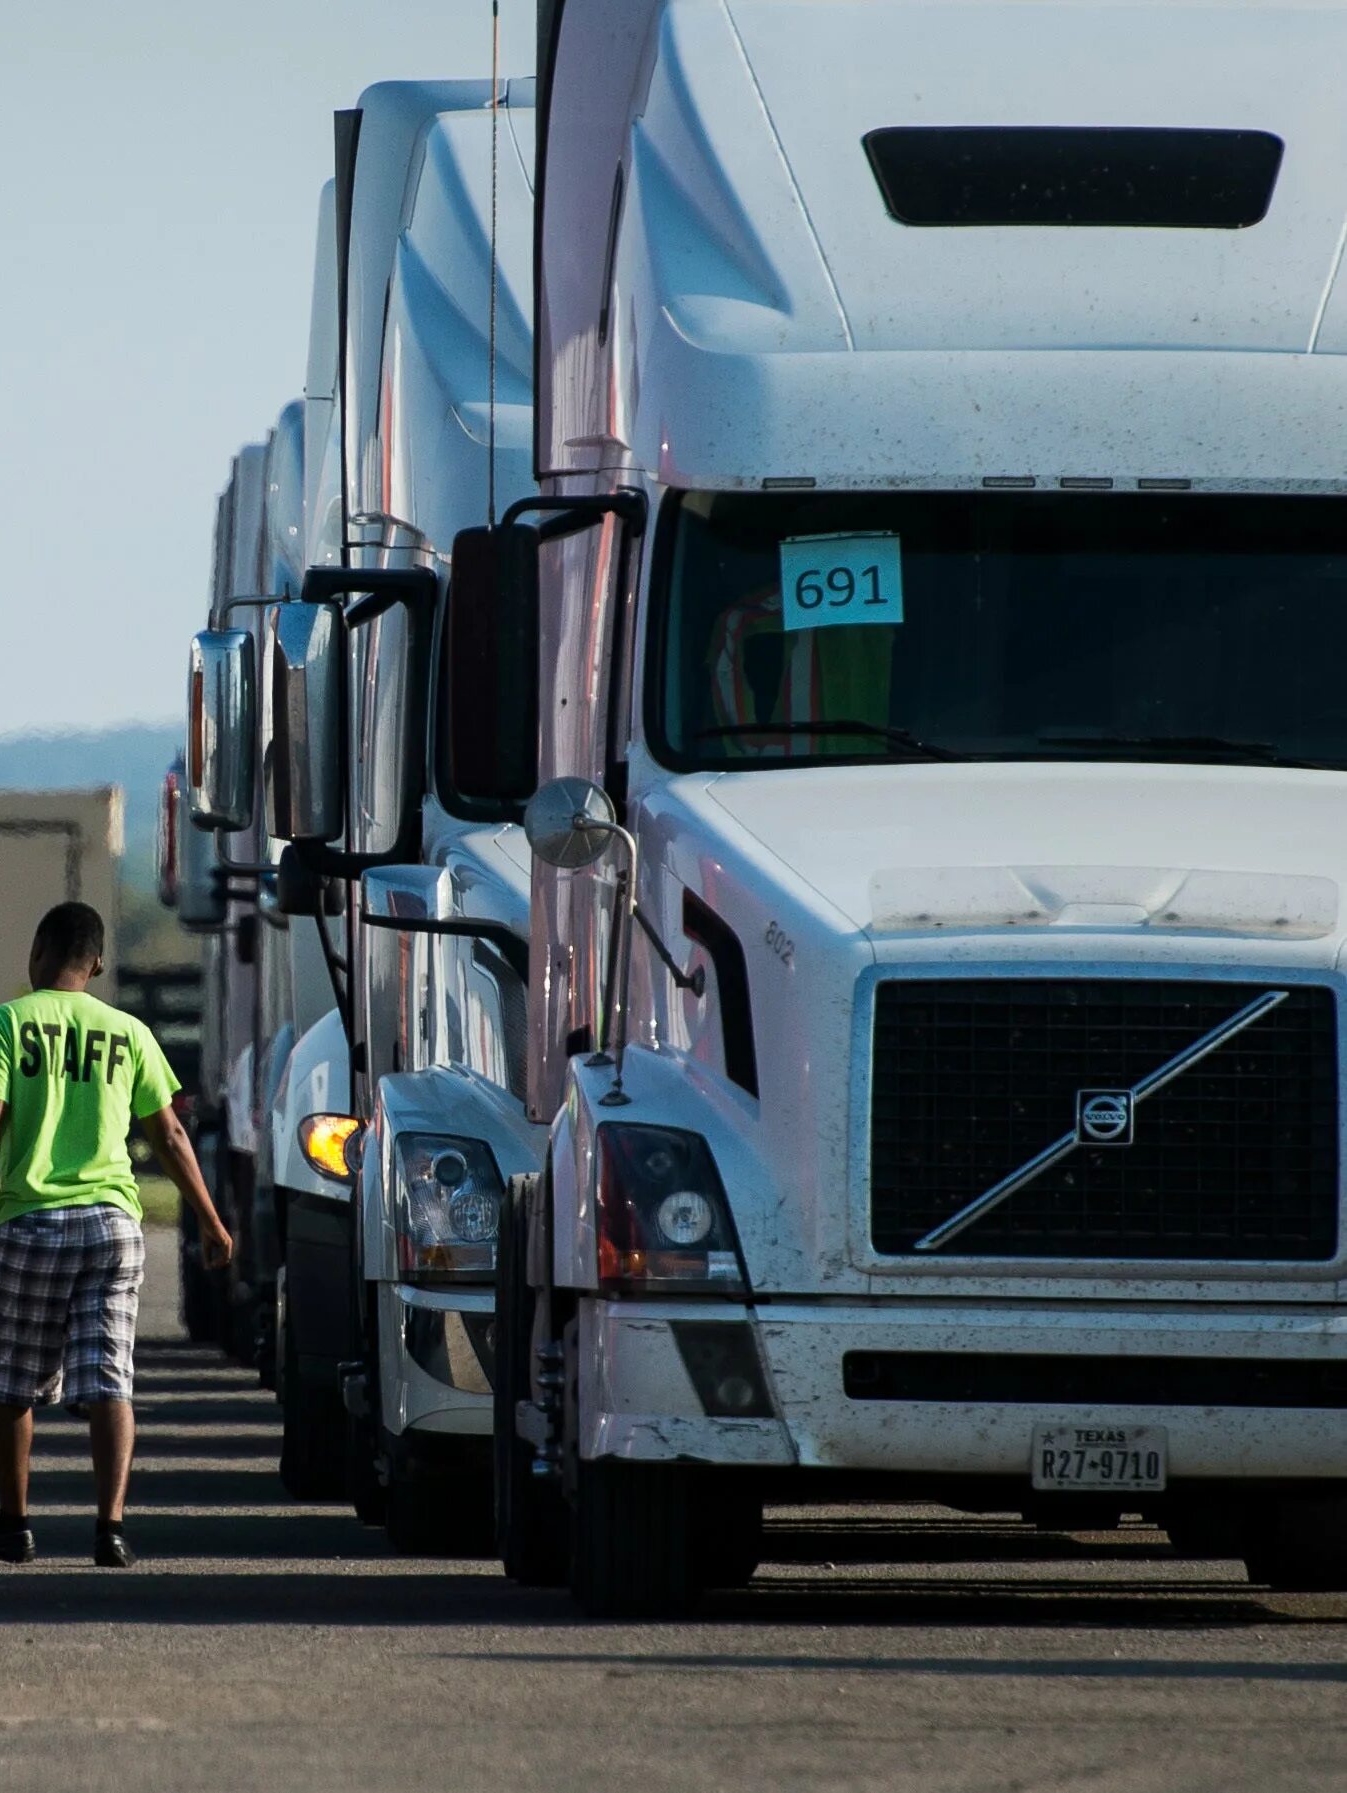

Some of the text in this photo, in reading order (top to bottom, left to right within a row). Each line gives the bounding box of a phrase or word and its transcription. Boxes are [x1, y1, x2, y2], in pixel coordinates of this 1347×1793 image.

[796, 565, 888, 609] 691
[765, 920, 796, 967] 802
[20, 1021, 130, 1085] STAFF
[1074, 1429, 1127, 1442] TEXAS
